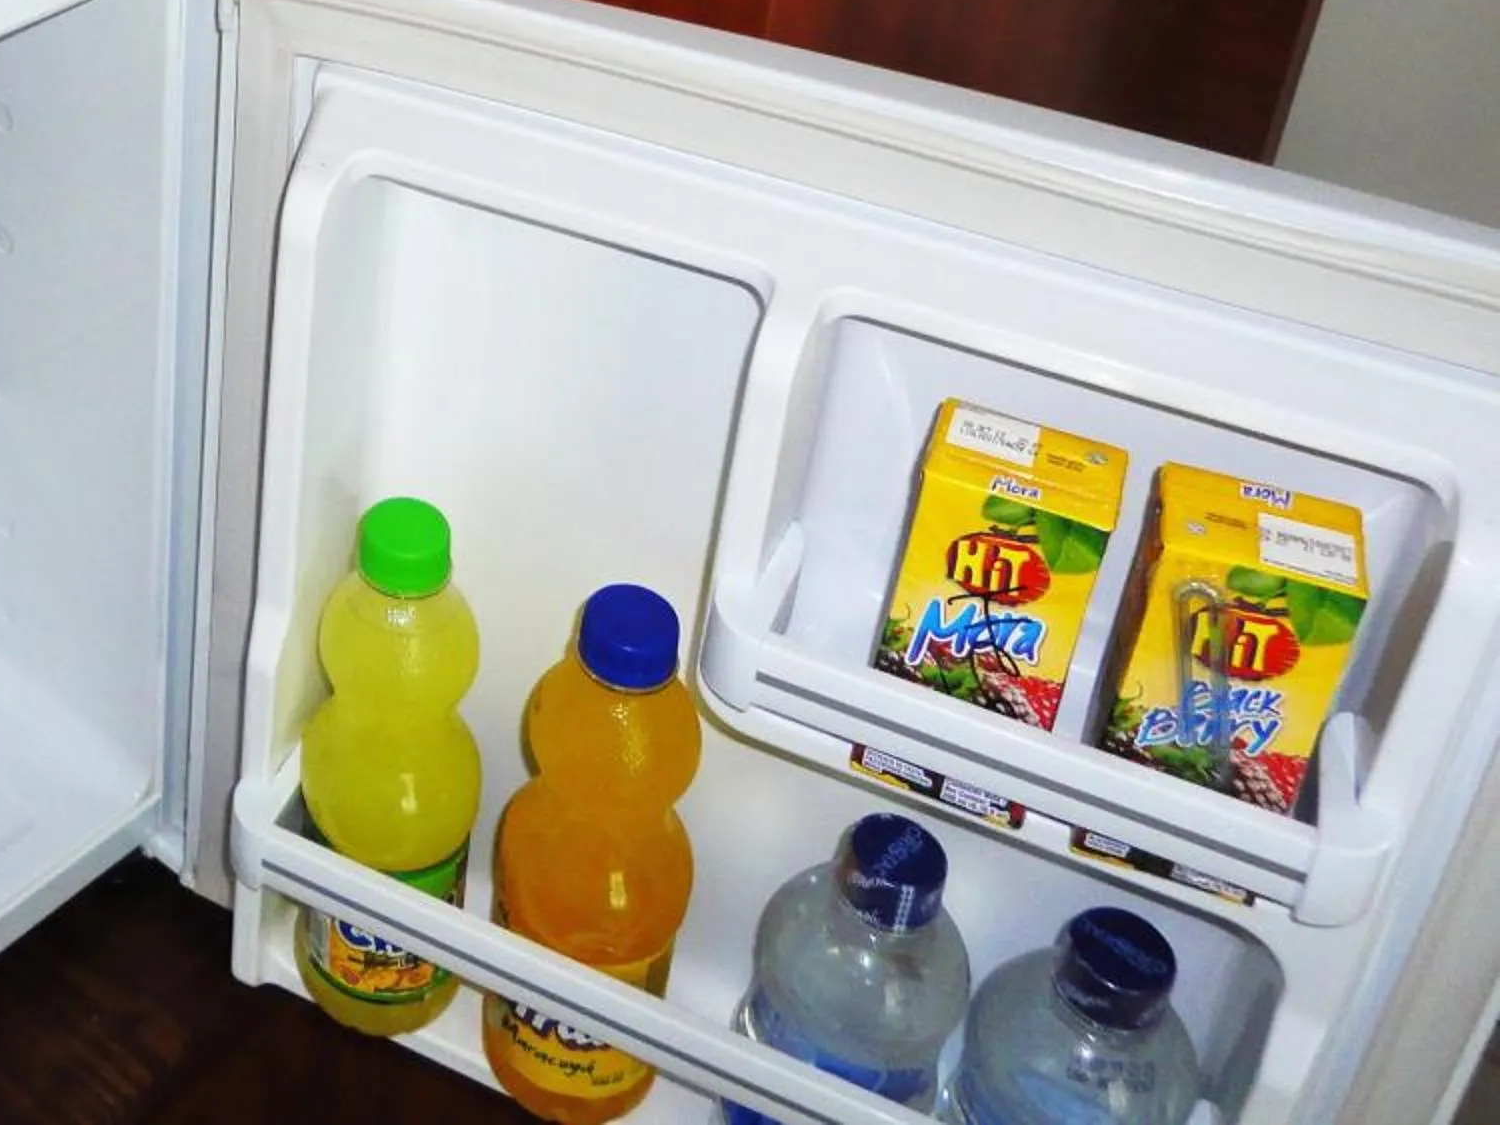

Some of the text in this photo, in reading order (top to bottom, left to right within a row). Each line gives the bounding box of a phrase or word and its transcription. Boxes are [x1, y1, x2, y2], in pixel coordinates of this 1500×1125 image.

[991, 477, 1041, 500] Mora
[1243, 485, 1292, 509] Mora
[905, 595, 1047, 667] Mora
